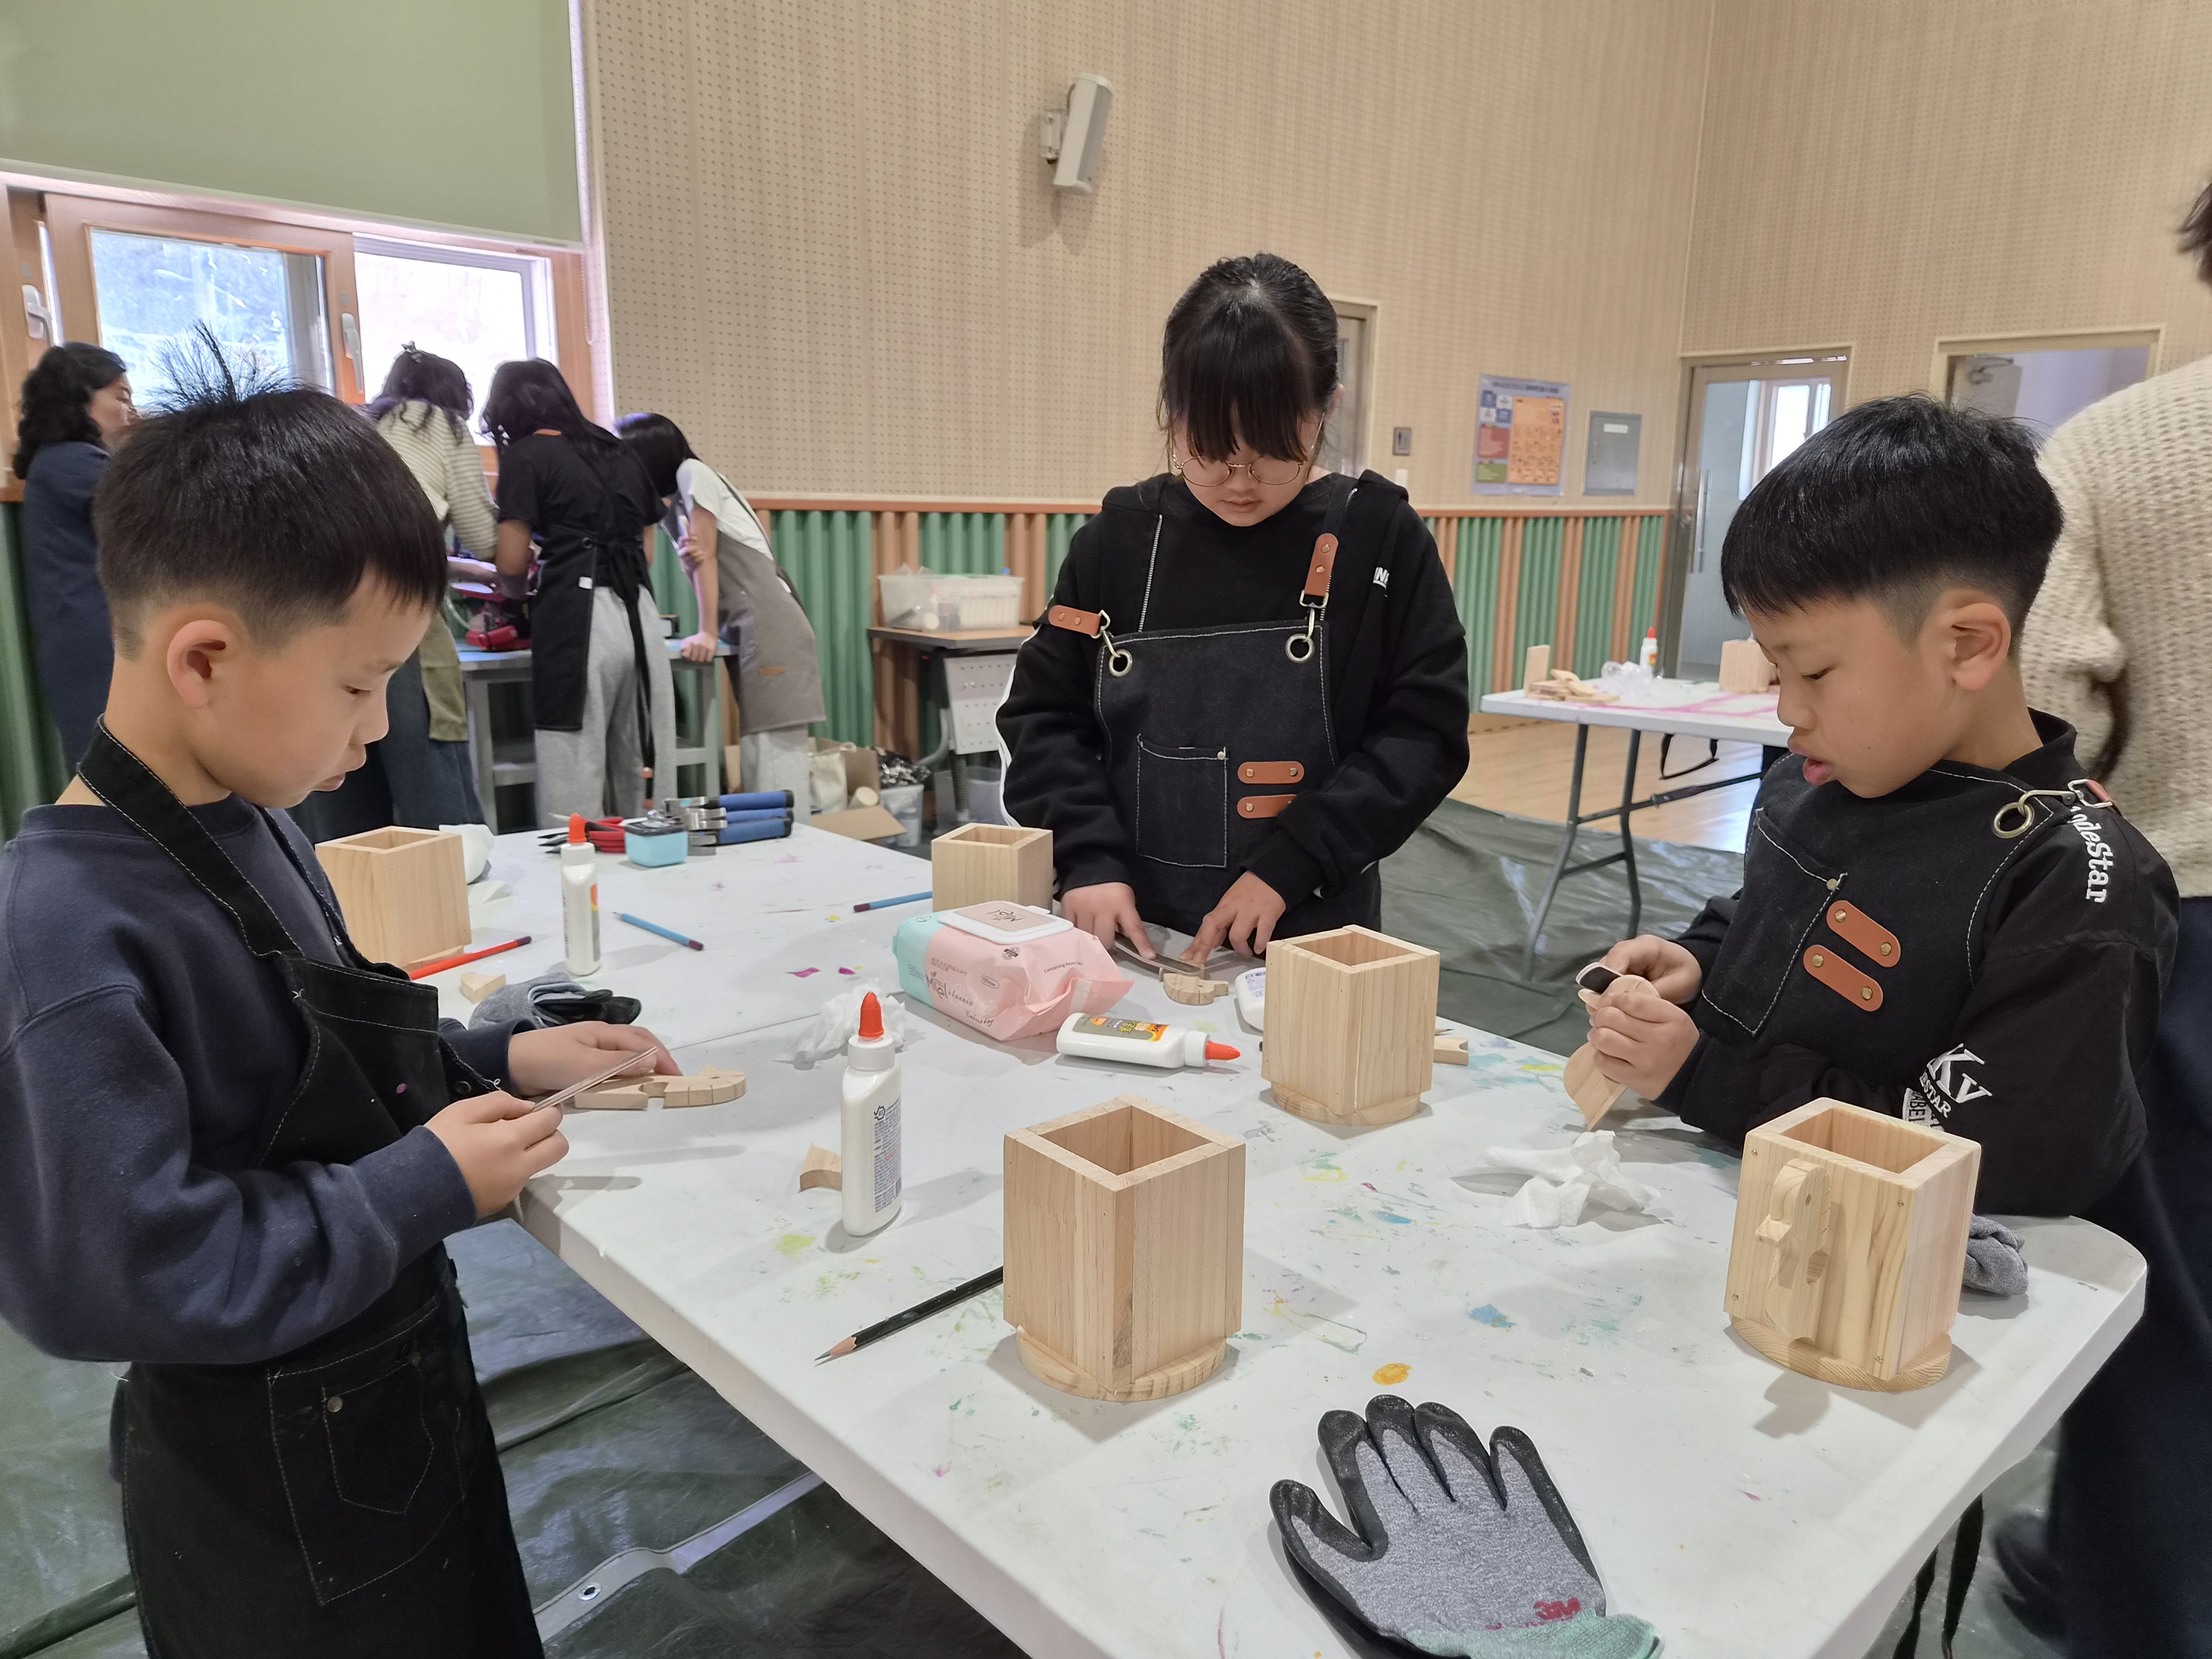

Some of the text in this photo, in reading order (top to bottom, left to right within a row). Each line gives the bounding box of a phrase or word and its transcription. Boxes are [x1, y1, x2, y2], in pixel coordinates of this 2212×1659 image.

[2067, 806, 2114, 904] odeStar
[926, 973, 948, 999] Miel
[948, 990, 973, 1006] classic
[1535, 1598, 1581, 1620] 3M
